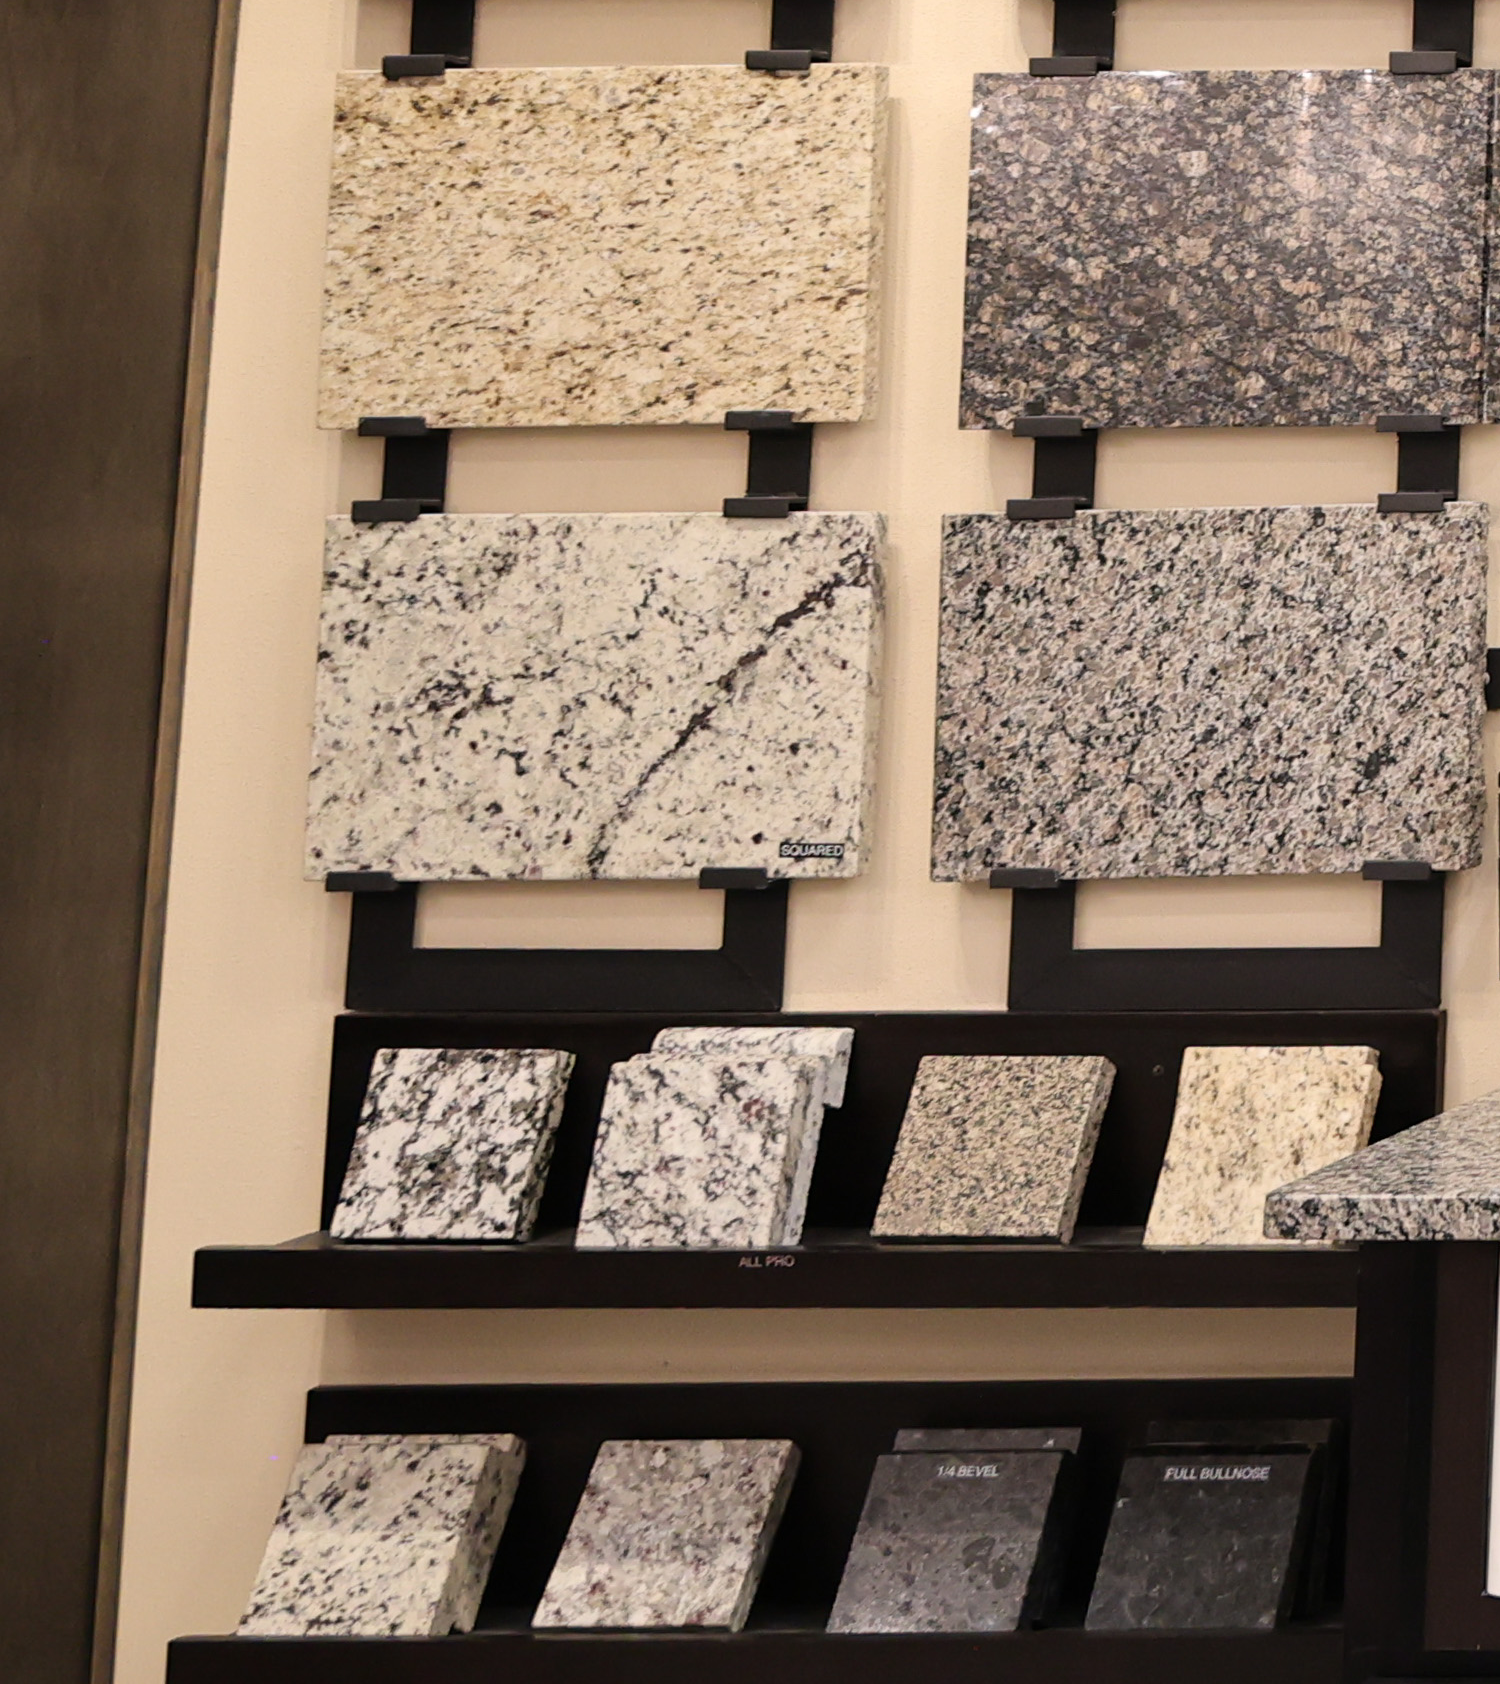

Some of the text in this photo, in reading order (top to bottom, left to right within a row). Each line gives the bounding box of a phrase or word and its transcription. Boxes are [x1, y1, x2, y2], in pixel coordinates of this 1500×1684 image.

[781, 844, 844, 857] SQUARED
[738, 1254, 796, 1268] ALL PRO
[937, 1464, 1001, 1477] 1/4 BEVEL
[1163, 1466, 1272, 1481] FULL BULLNOSE
